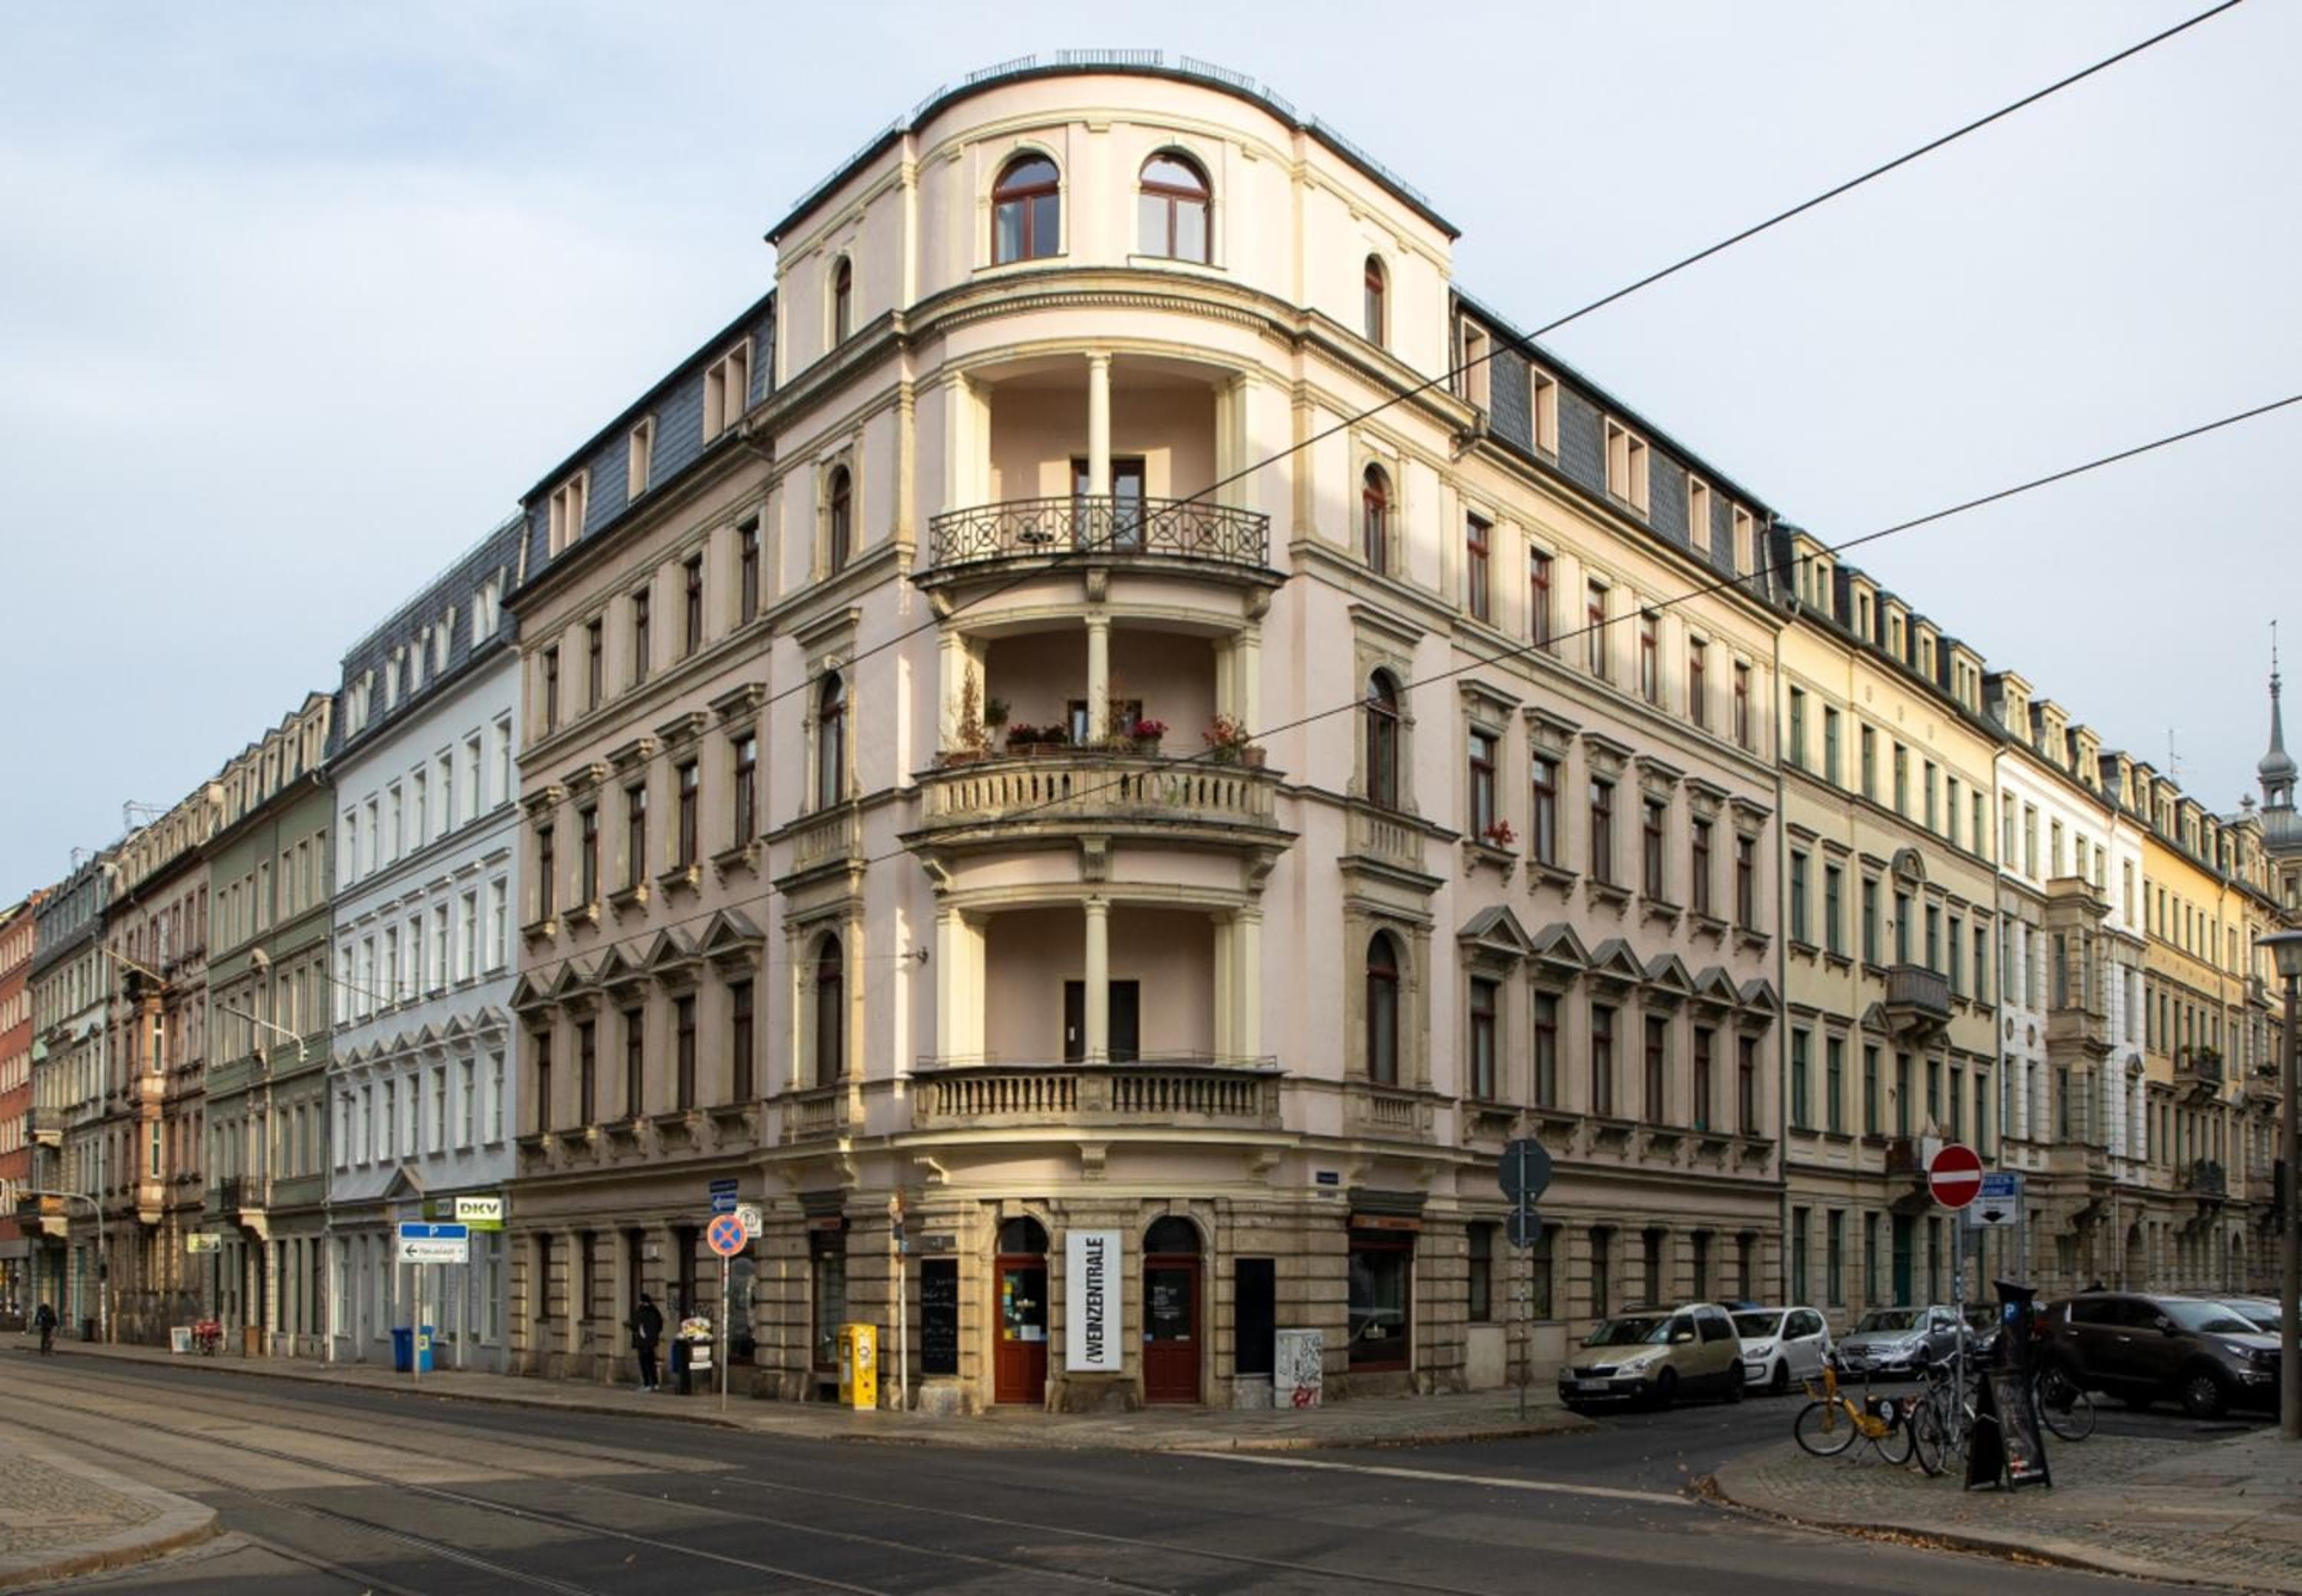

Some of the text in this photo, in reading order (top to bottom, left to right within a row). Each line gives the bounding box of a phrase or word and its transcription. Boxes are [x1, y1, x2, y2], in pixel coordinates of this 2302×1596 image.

[460, 1202, 498, 1214] DKV
[429, 1225, 439, 1238] P
[2004, 1303, 2014, 1318] P
